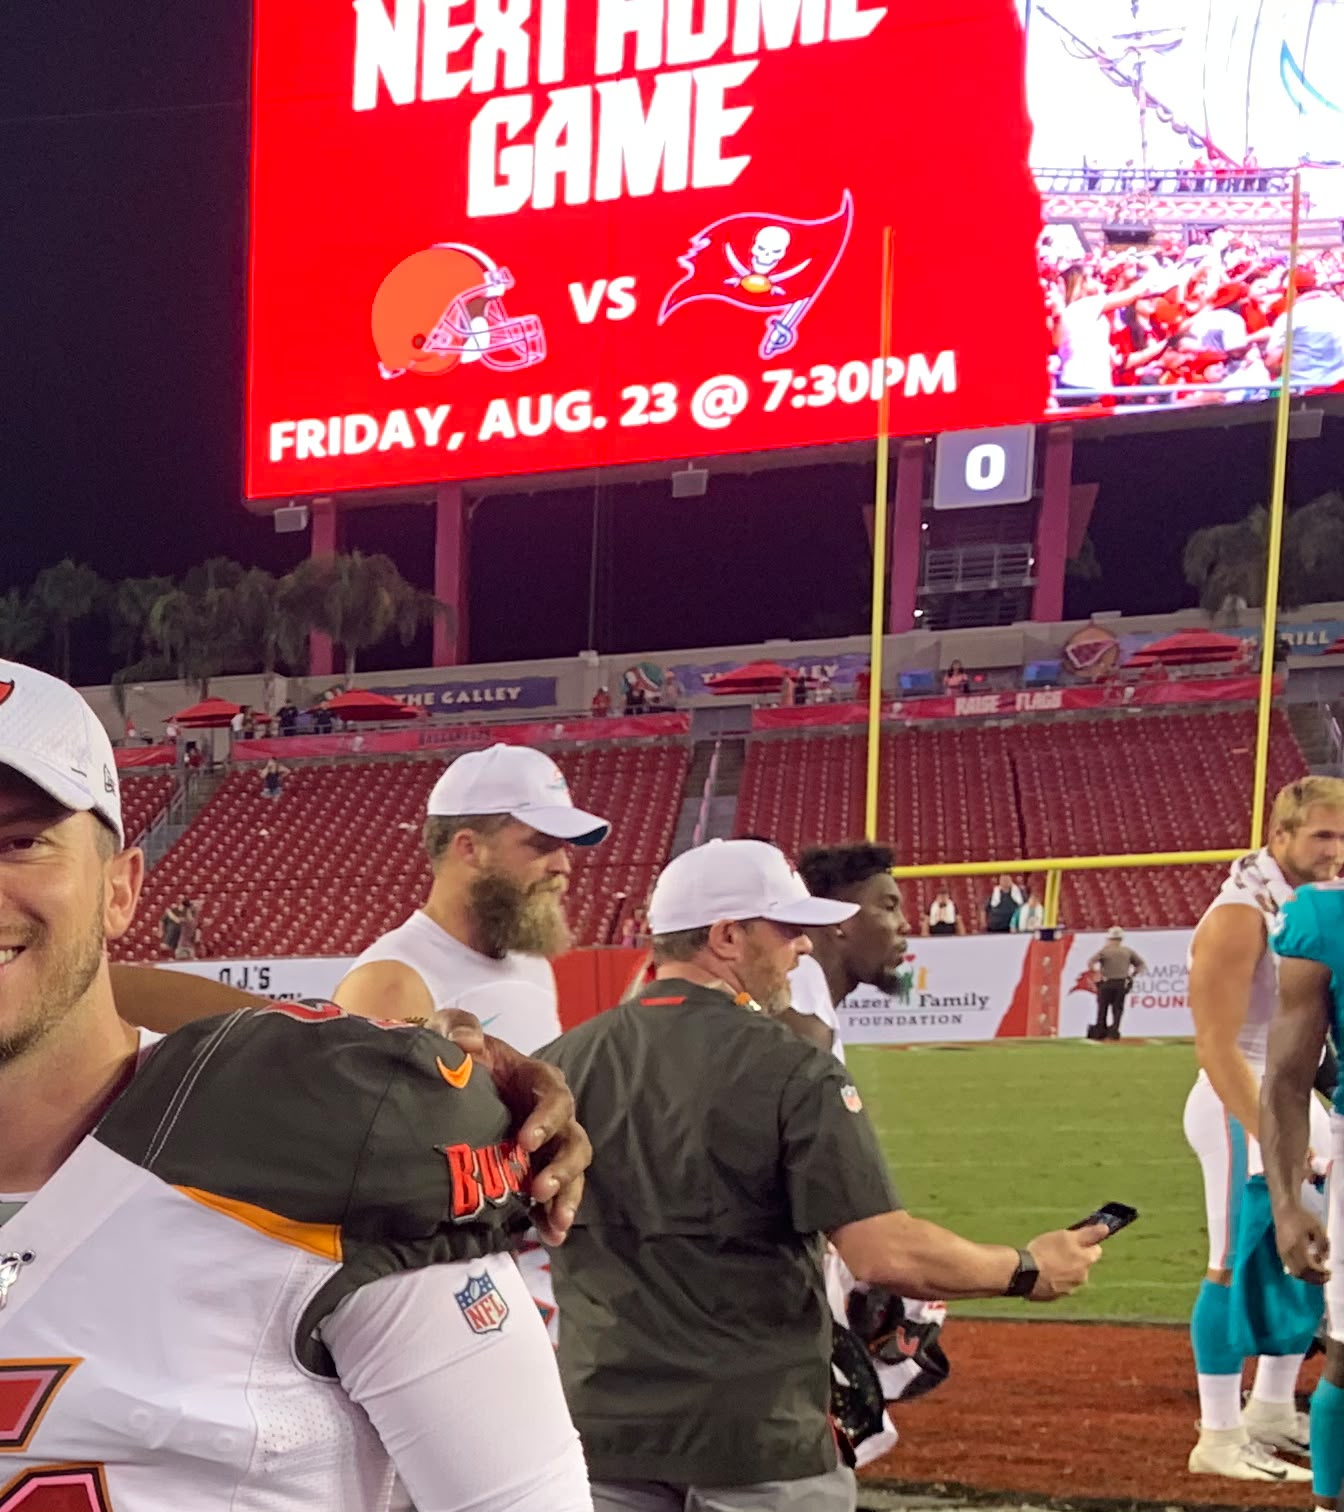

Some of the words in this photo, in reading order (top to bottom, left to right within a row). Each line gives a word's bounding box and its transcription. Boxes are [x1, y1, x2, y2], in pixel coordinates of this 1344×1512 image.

[352, 0, 573, 112] NEXT
[466, 60, 760, 218] GAME
[568, 276, 637, 325] VS
[268, 403, 464, 463] FRIDAY,
[478, 389, 607, 443] AUG.
[620, 381, 678, 427] 23
[690, 375, 749, 430] @
[761, 349, 958, 414] 7:30PM
[965, 443, 1006, 491] 0
[441, 687, 522, 704] GALLEY
[842, 995, 892, 1010] lazer
[919, 992, 990, 1011] Family
[1130, 979, 1186, 994] BUCC
[1130, 994, 1188, 1009] FOUN
[848, 1014, 964, 1027] FOUNDATION
[465, 1293, 507, 1331] NFL
